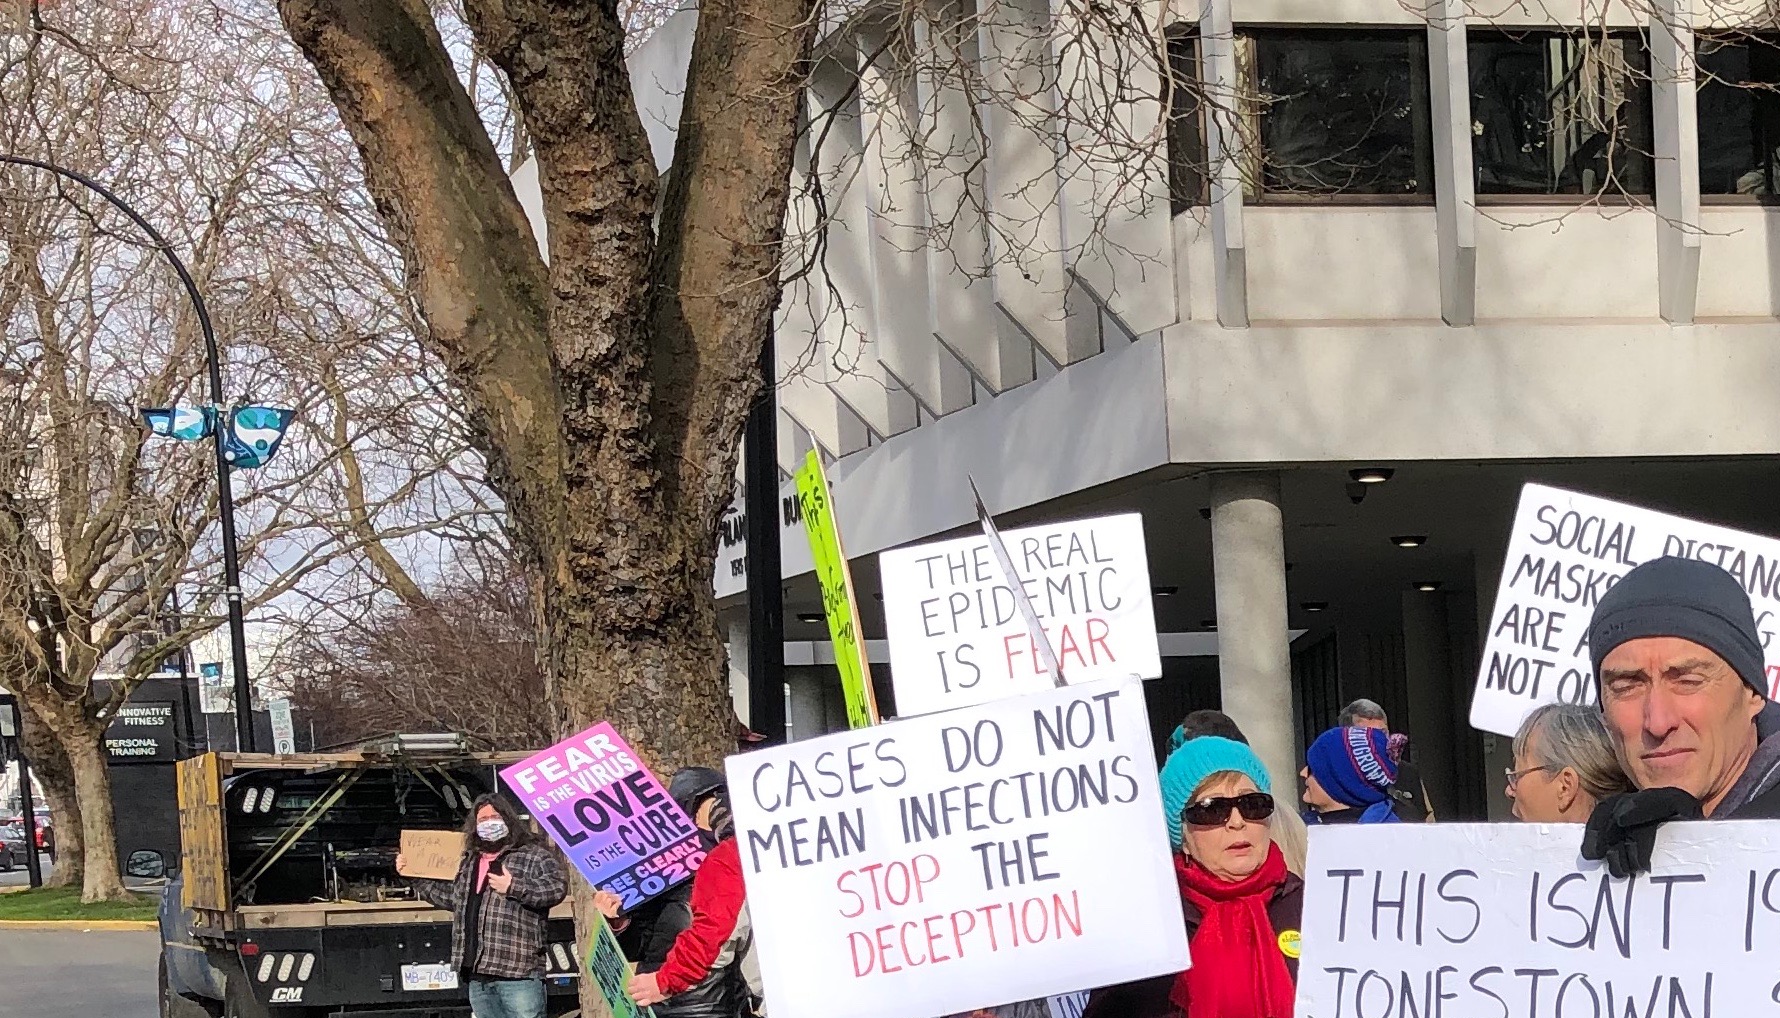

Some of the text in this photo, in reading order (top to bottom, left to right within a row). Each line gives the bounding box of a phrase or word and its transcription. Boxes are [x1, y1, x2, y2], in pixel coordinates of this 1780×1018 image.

[914, 529, 1114, 589] THE REAL
[1530, 504, 1639, 568] SOCIAL
[920, 566, 1122, 637] EPIDEMIC
[1495, 603, 1566, 652] ARE
[937, 617, 1116, 693] IS FEAR
[1486, 650, 1556, 700] NOT
[105, 738, 159, 748] PERSONAL
[108, 747, 156, 756] TRAINING
[124, 716, 165, 726] FITNESS
[752, 690, 1120, 812] CASES DO NOT
[513, 733, 620, 795] FEAR
[532, 751, 639, 812] IS THE VIRUS
[546, 770, 665, 847] LOVE
[584, 800, 693, 870] IS THE CURE
[747, 755, 1139, 874] MEAN INFECTIONS
[634, 835, 703, 879] CLEARLY
[835, 832, 1061, 919] STOP THE
[846, 889, 1083, 979] DECEPTION
[1326, 868, 1481, 944] THIS
